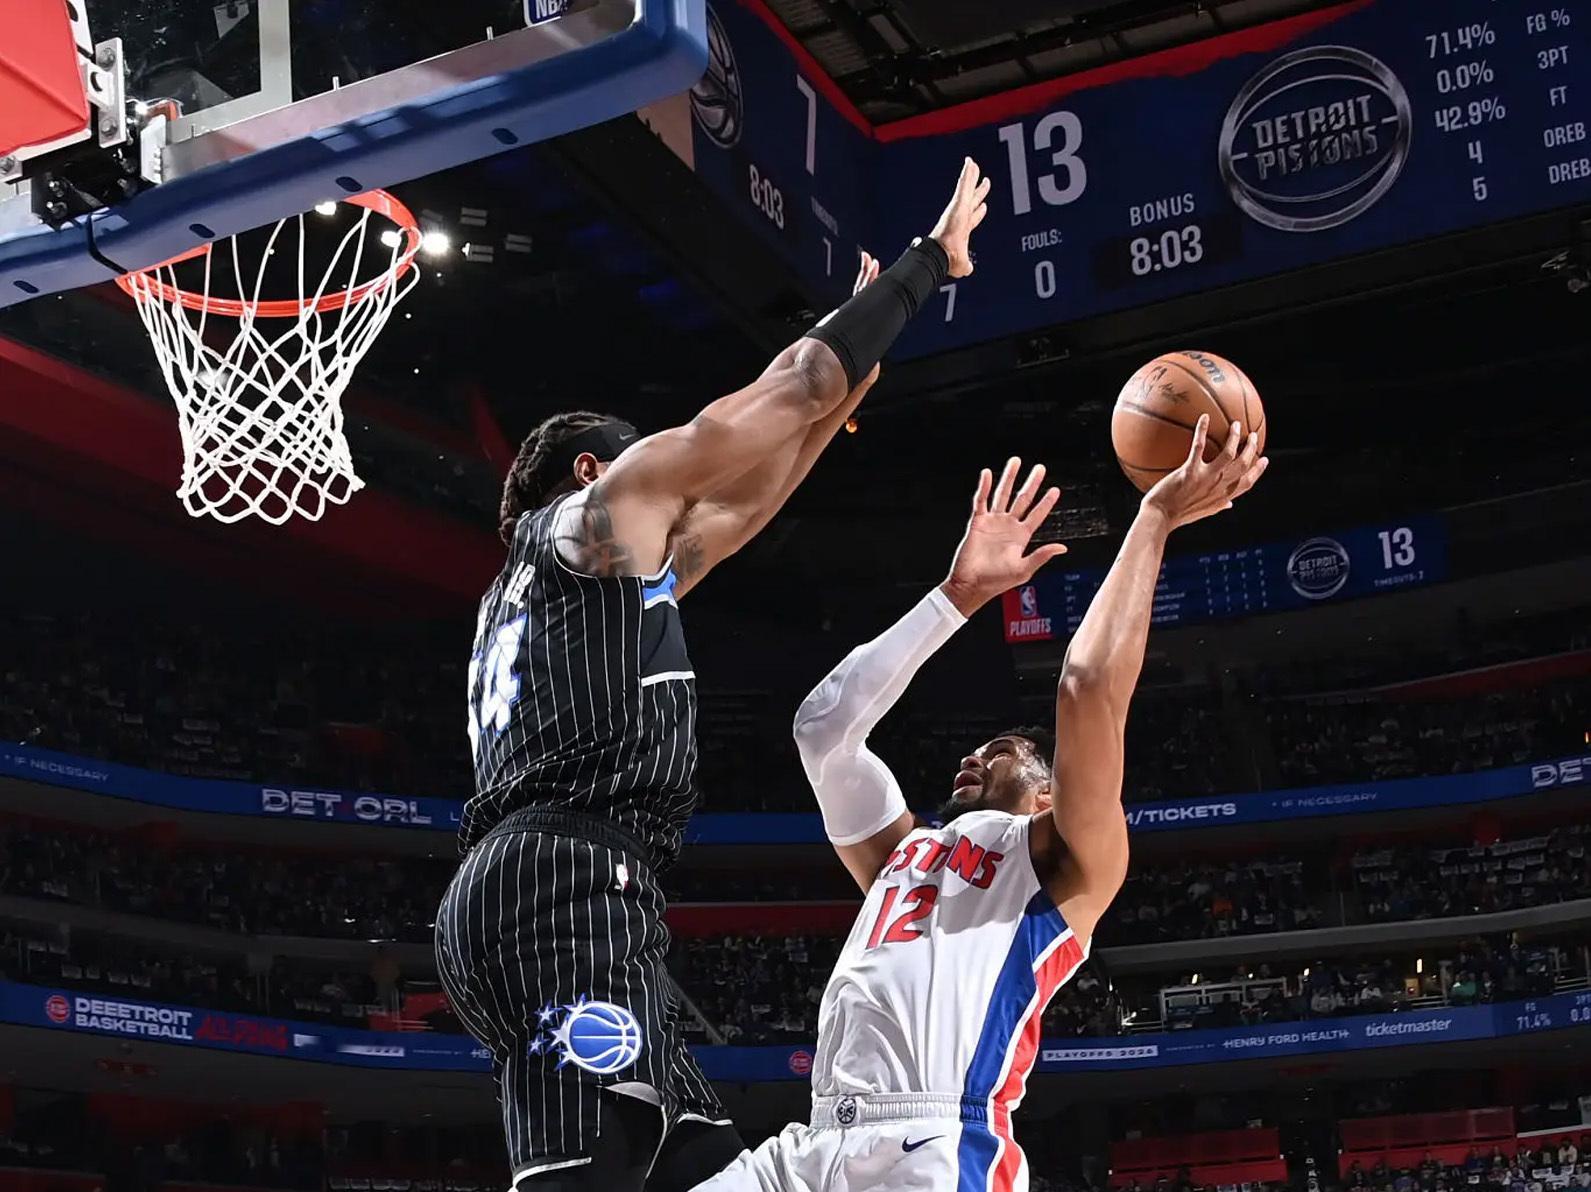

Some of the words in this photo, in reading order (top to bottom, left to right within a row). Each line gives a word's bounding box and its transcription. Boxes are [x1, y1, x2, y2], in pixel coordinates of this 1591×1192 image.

[1425, 22, 1496, 59] 71.4%
[1526, 13, 1547, 35] FG
[1551, 8, 1571, 28] %
[1436, 61, 1494, 93] 0.0%
[1537, 45, 1569, 70] 3PT
[796, 74, 817, 176] 7
[1252, 94, 1373, 149] DETROIT
[1435, 97, 1506, 132] 42.9%
[1549, 86, 1568, 107] FT
[999, 110, 1088, 215] 13
[1256, 125, 1379, 180] PISTONS
[1468, 140, 1484, 165] 4
[1543, 122, 1587, 148] OREB
[749, 163, 785, 230] 8:03
[1473, 177, 1488, 201] 5
[1548, 157, 1591, 184] DREB
[1129, 192, 1195, 226] BONUS
[1021, 228, 1063, 252] FOULS:
[1130, 224, 1204, 276] 8:03
[1034, 260, 1057, 299] 0
[939, 282, 957, 322] 7
[1298, 554, 1338, 571] DETROIT
[1377, 526, 1417, 570] 13
[1009, 616, 1052, 637] PLAYOFFS
[30, 758, 109, 781] NECESSARY
[261, 788, 342, 817] DET
[354, 796, 433, 825] ORL
[865, 884, 938, 950] 12
[74, 997, 194, 1026] DEEETROIT
[74, 1013, 194, 1041] BASKETBALL
[1223, 1032, 1265, 1049] HENRY
[1267, 1034, 1300, 1046] FORD
[1302, 1029, 1350, 1043] HEALTH
[1365, 1018, 1452, 1038] ticketmaster
[1516, 1012, 1553, 1031] 71.4%
